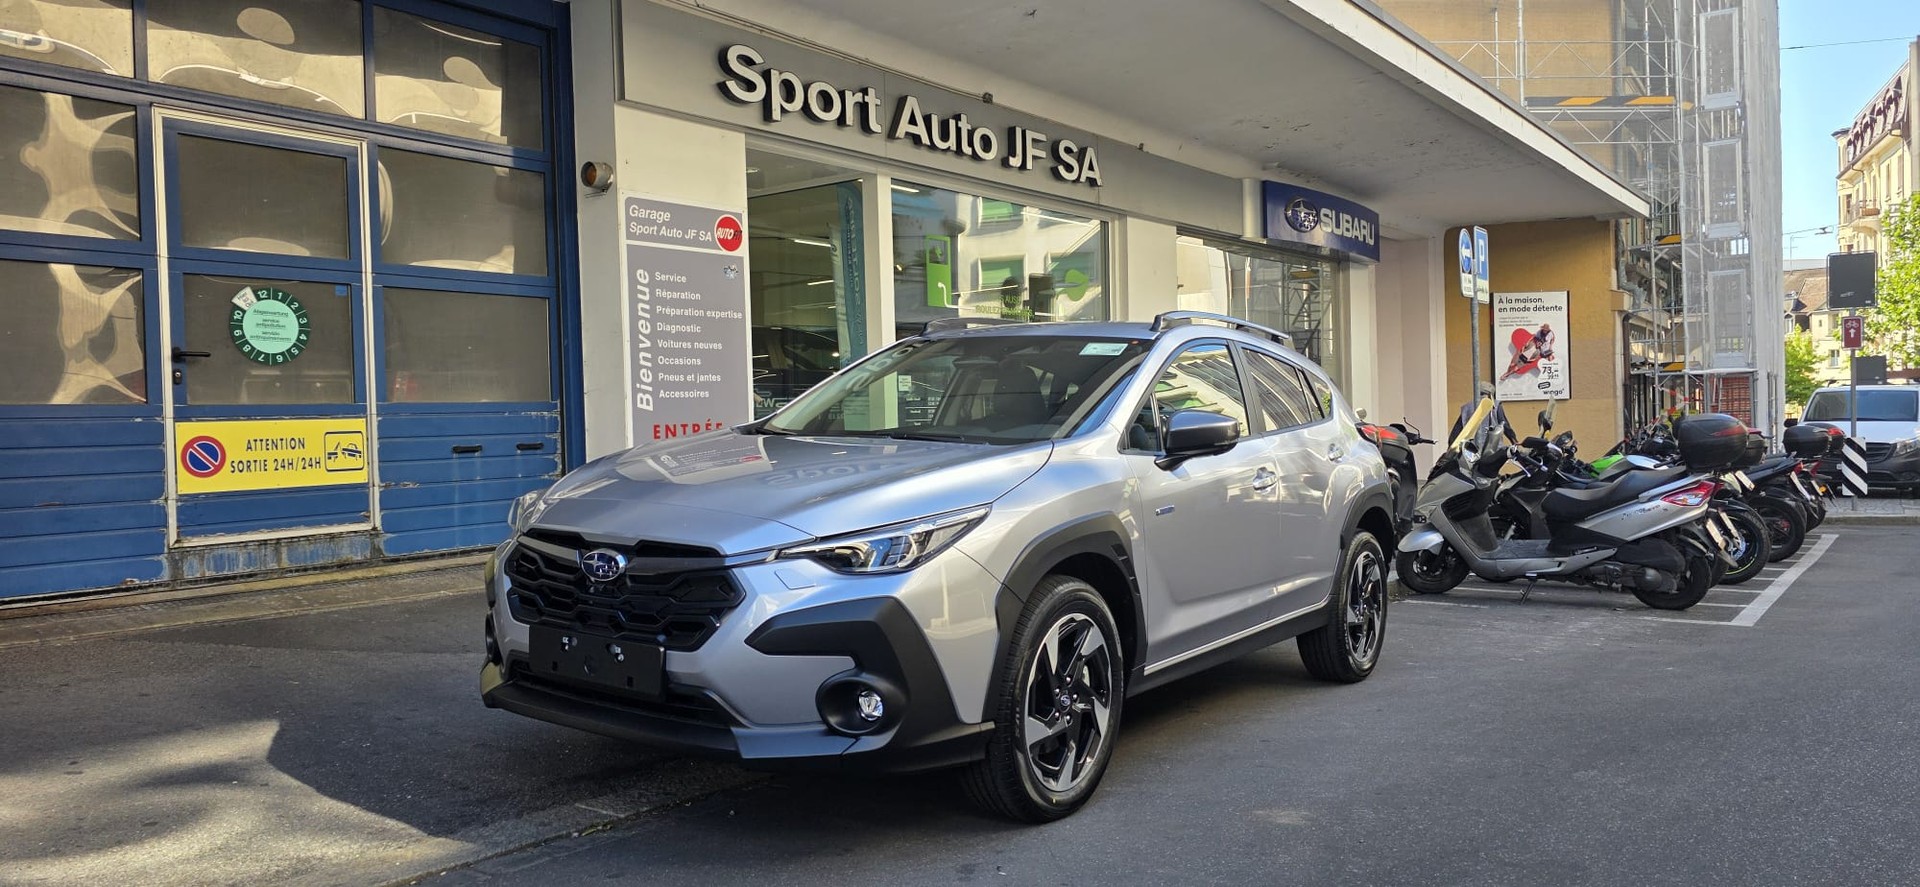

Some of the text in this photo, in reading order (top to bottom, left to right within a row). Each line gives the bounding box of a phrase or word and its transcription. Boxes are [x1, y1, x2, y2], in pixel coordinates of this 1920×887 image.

[718, 43, 1102, 187] Sport Auto JF SA
[629, 204, 671, 223] Garage
[629, 221, 712, 242] Sport Auto JF SA
[1320, 208, 1375, 246] SUBARU
[1479, 239, 1485, 274] P
[655, 271, 687, 283] Service
[257, 290, 268, 299] 12
[277, 292, 283, 300] 1
[656, 288, 701, 300] Réparation
[290, 302, 299, 310] 2
[1509, 305, 1531, 313] mode
[1532, 304, 1563, 312] détente
[233, 310, 243, 320] 10
[656, 305, 743, 319] Préparation expertise
[657, 322, 702, 334] Diagnostic
[299, 333, 308, 341] 4
[636, 269, 653, 411] Bienvenue
[242, 344, 251, 353] 8
[657, 339, 723, 350] Voitures neuves
[290, 347, 299, 356] 5
[257, 354, 266, 362] 7
[658, 356, 702, 366] Occasions
[658, 373, 722, 383] Pneus et jantes
[659, 390, 710, 399] Accessoires
[246, 437, 306, 452] ATTENTION
[230, 457, 321, 474] SORTIE 24H/24H
